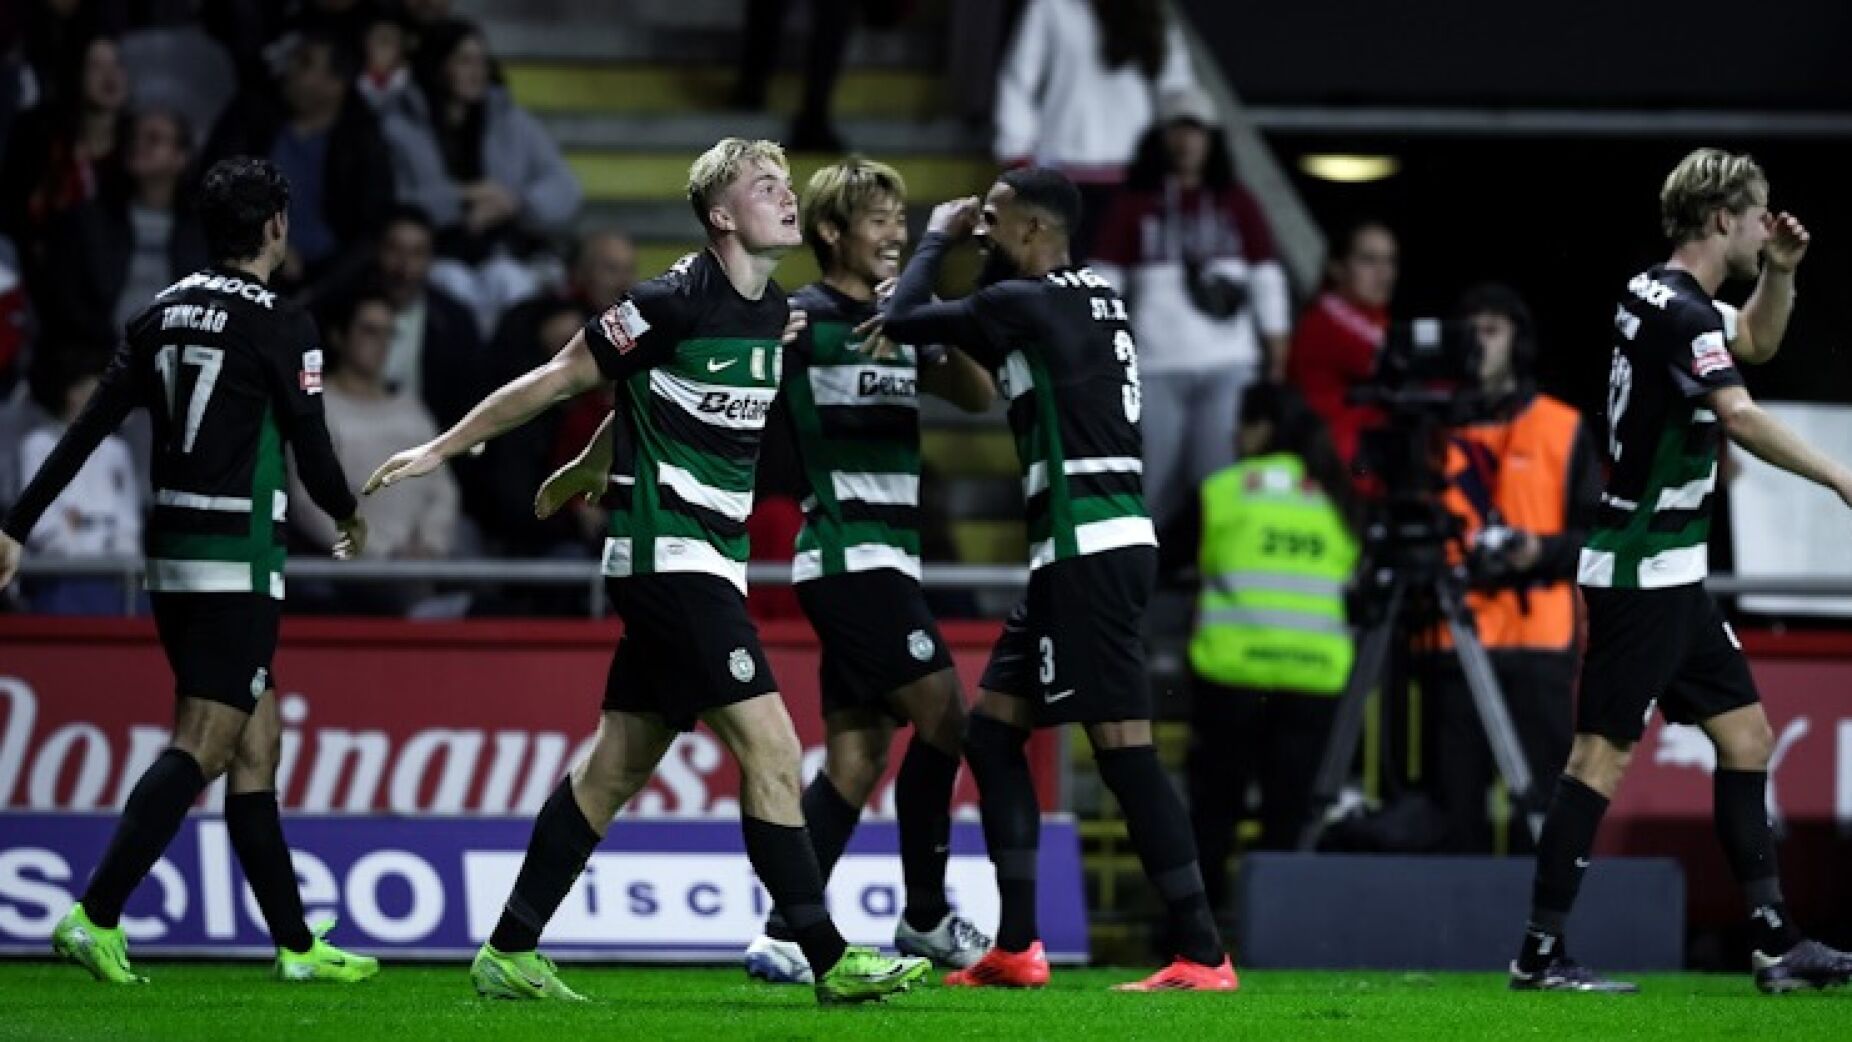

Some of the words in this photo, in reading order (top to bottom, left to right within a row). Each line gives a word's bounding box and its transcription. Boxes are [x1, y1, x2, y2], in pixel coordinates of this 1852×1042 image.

[155, 345, 225, 453] 17
[1112, 329, 1142, 423] 3
[1039, 636, 1054, 684] 3
[0, 820, 445, 940] soleo
